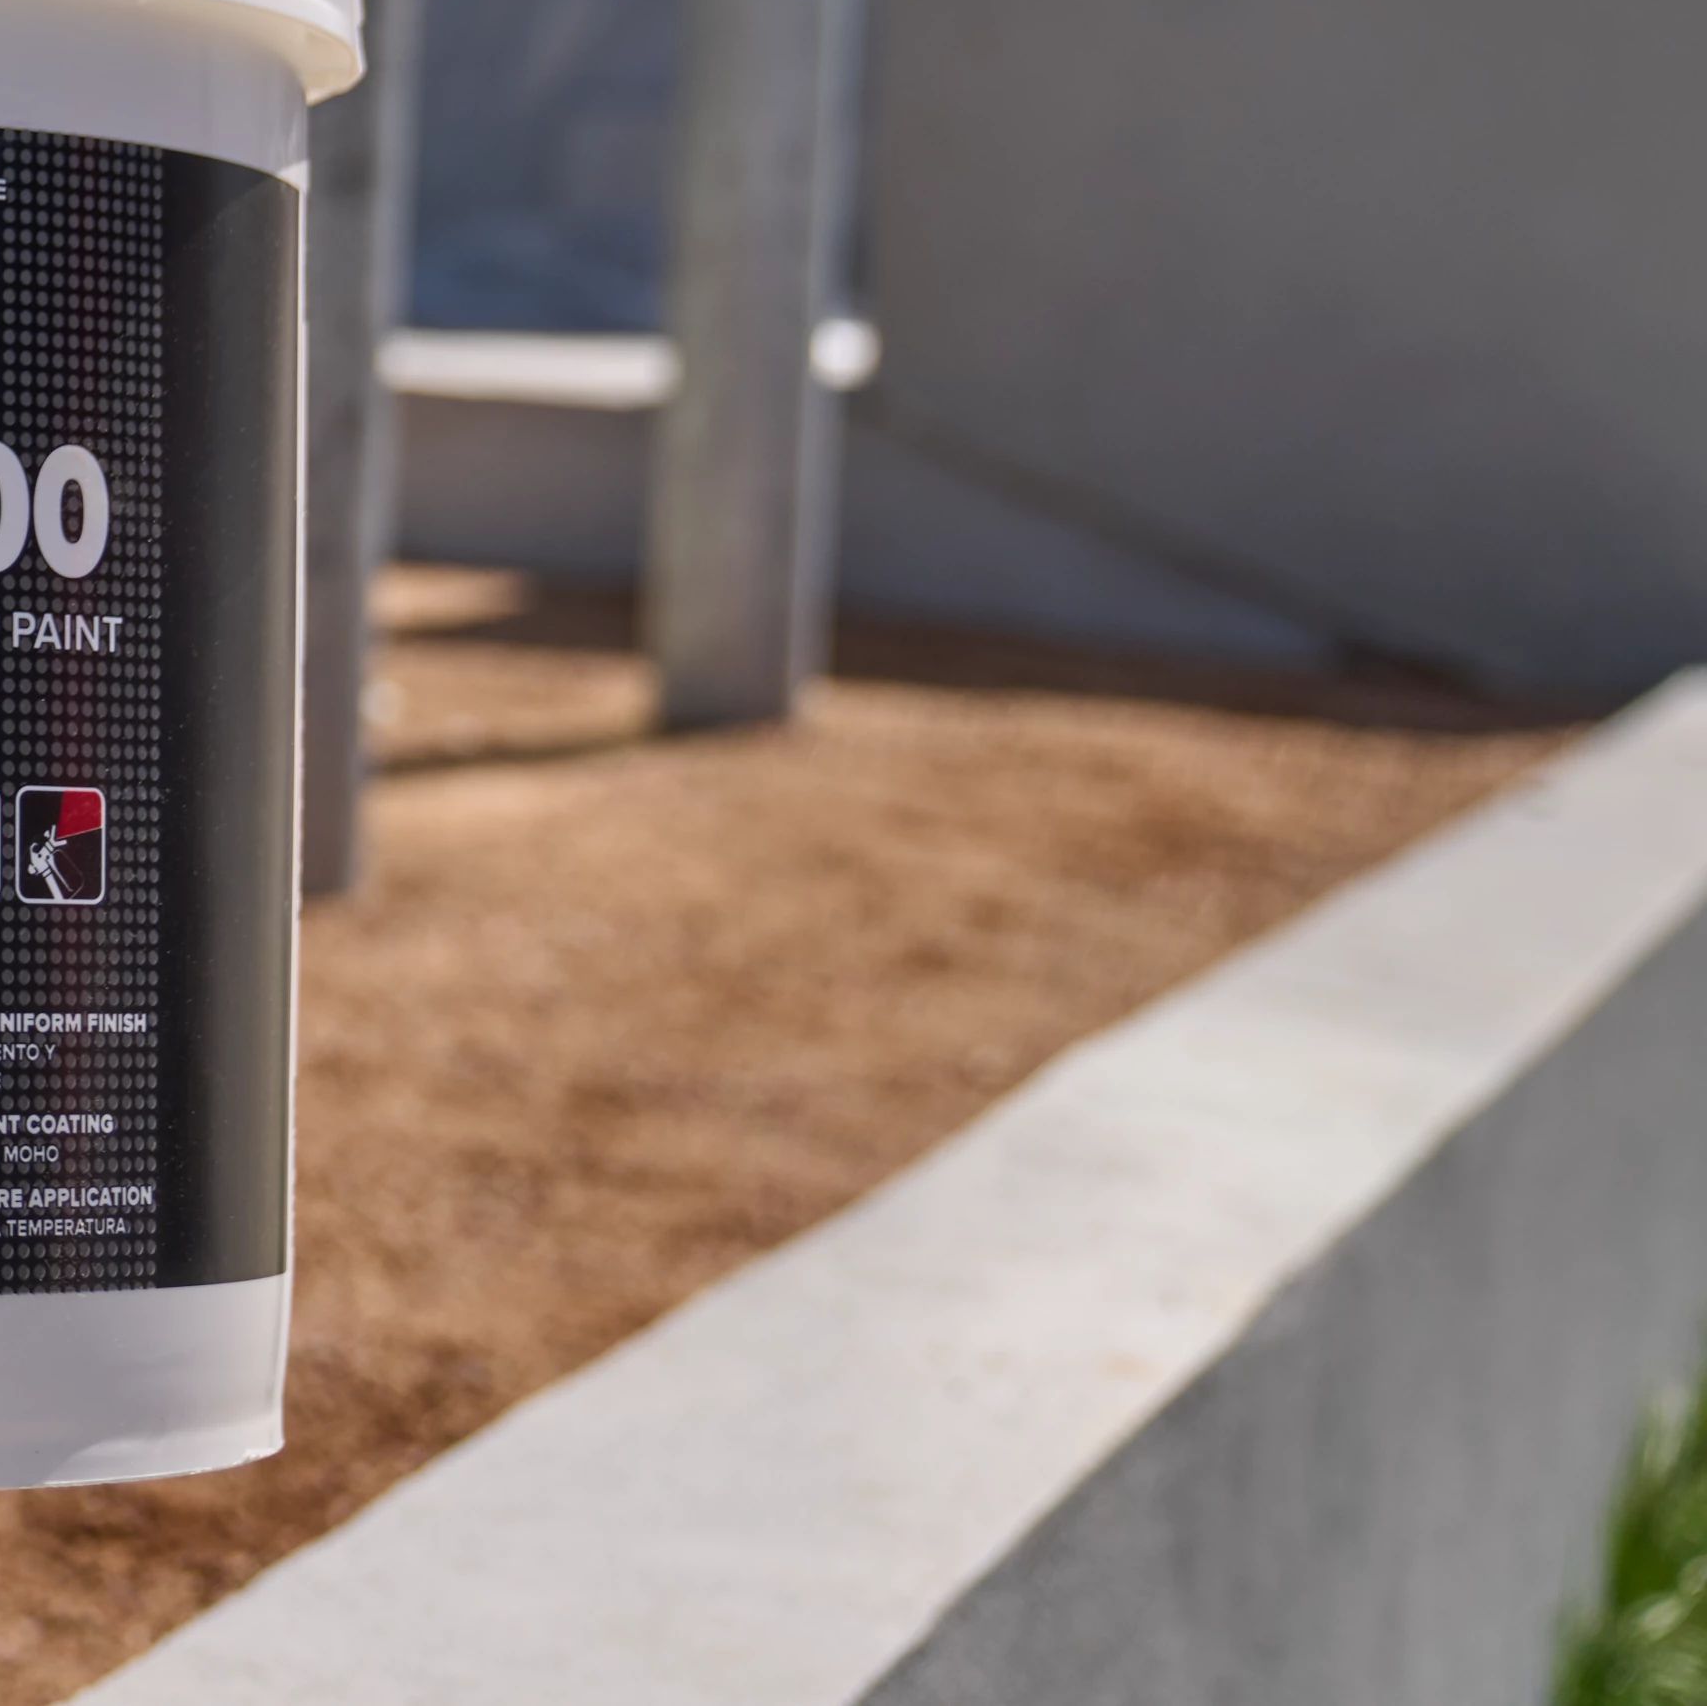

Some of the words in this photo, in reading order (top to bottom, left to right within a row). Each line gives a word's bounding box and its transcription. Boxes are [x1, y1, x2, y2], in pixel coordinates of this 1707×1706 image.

[11, 611, 123, 653] PAINT
[87, 1013, 148, 1034] FINISH
[43, 1044, 56, 1061] Y
[25, 1114, 115, 1135] COATING
[3, 1145, 60, 1163] MOHO
[28, 1186, 154, 1208] APPLICATION
[5, 1218, 127, 1237] TEMPERATURA
